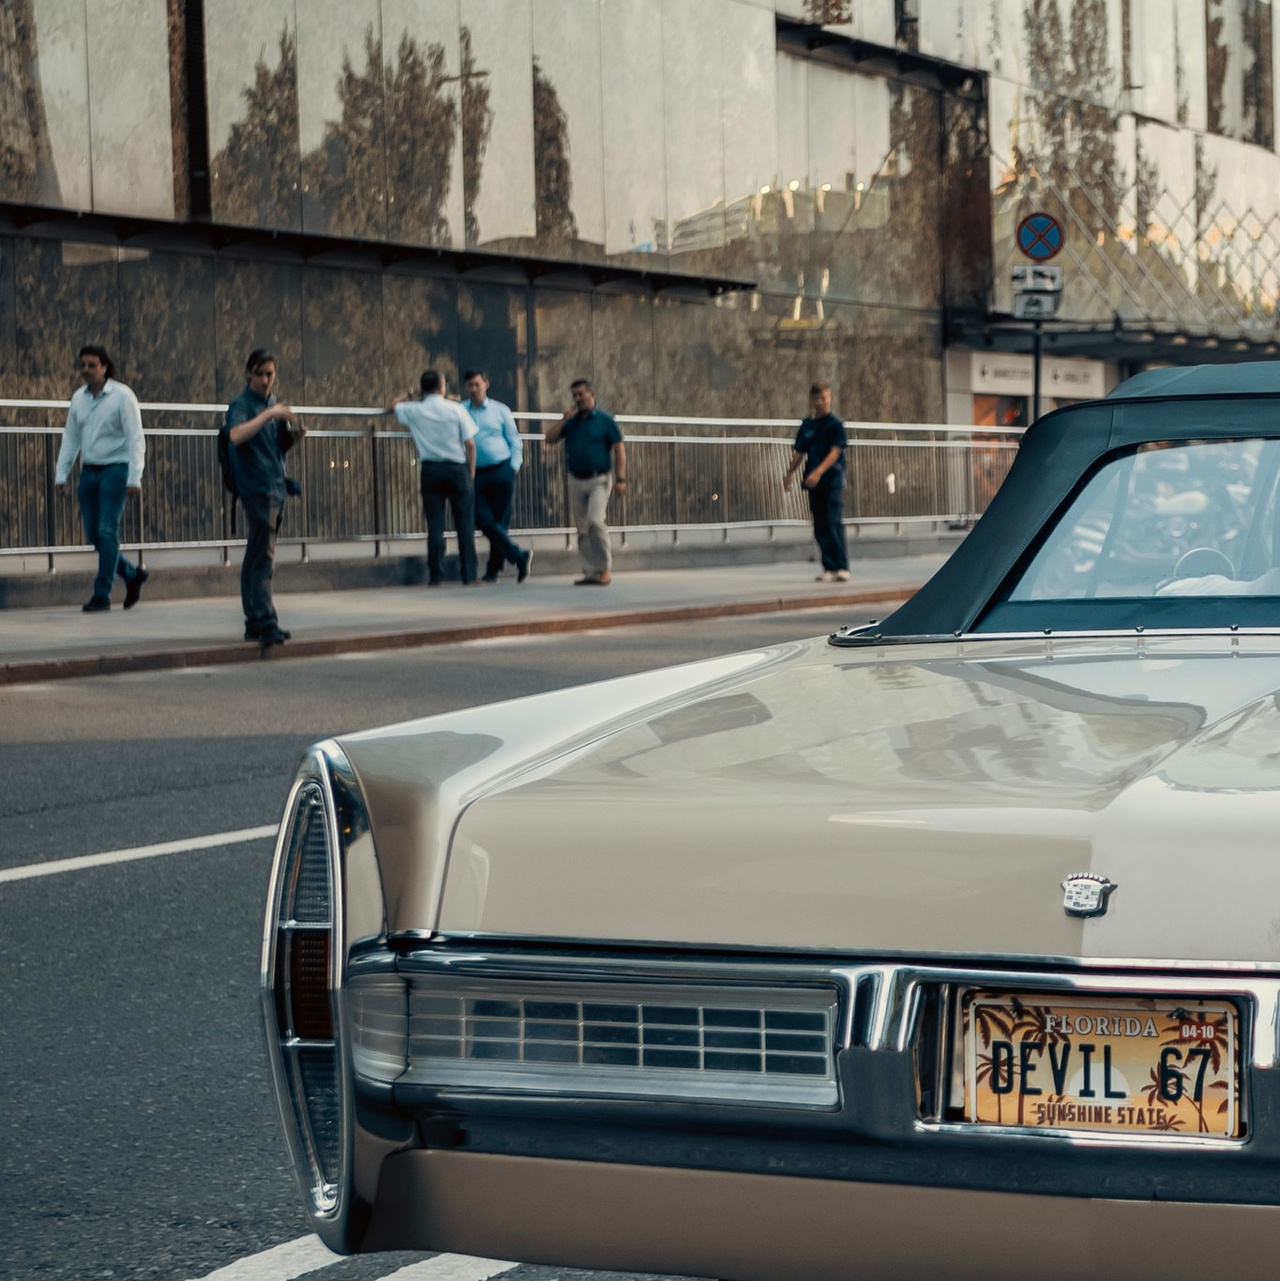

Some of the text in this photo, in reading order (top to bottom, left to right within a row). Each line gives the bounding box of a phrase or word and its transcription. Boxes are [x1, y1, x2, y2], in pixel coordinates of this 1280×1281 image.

[1044, 1014, 1159, 1038] FLORIDA
[1181, 1023, 1215, 1039] 04-10
[991, 1041, 1212, 1103] DEVIL 67
[1036, 1102, 1165, 1126] SUNSHINE STATE
